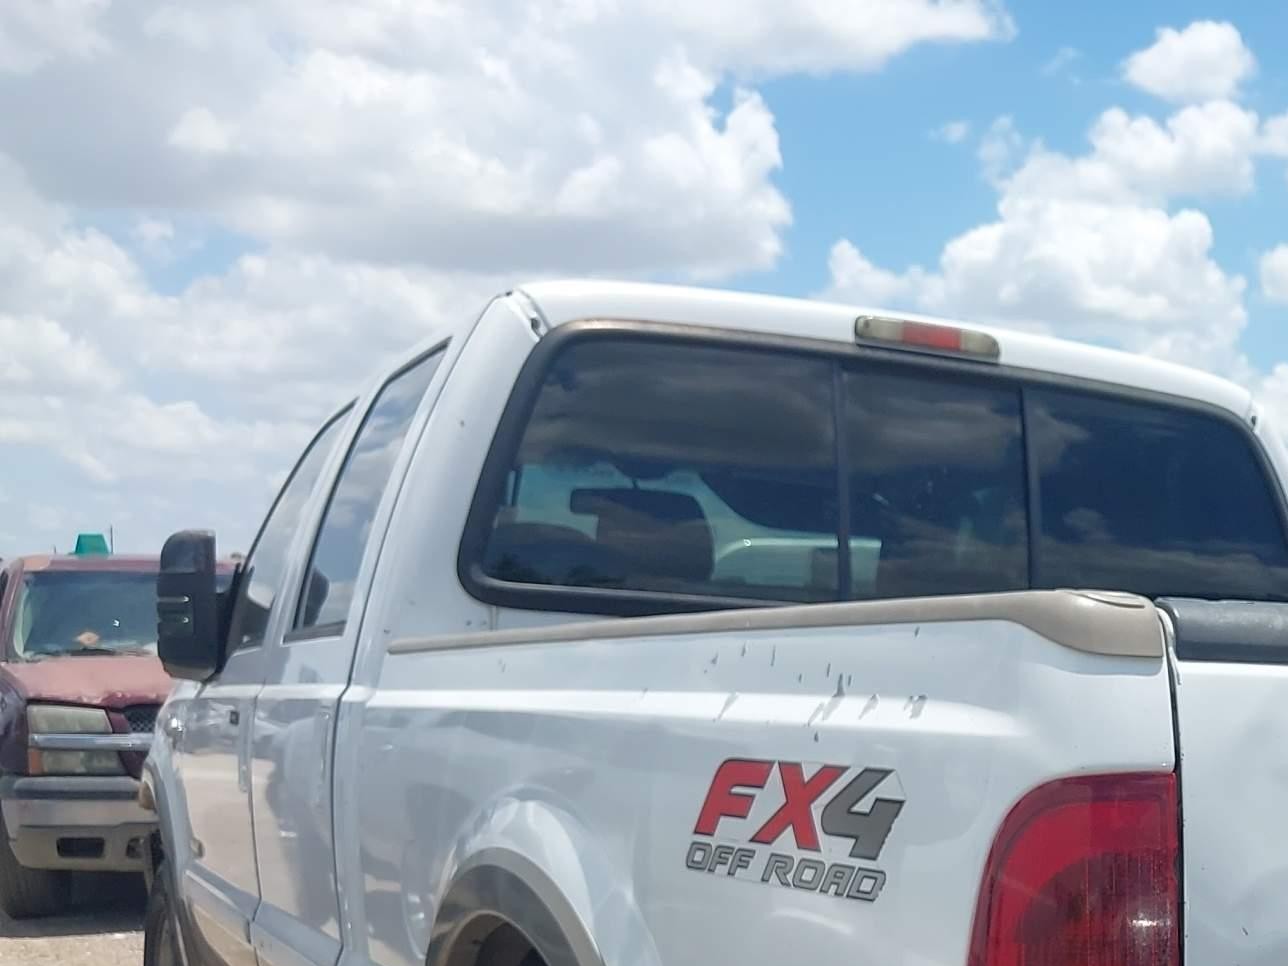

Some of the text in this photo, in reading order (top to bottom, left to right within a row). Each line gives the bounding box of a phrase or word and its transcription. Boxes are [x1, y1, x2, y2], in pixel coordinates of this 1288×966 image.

[693, 757, 906, 861] FX4
[686, 841, 887, 902] OFF ROAD
